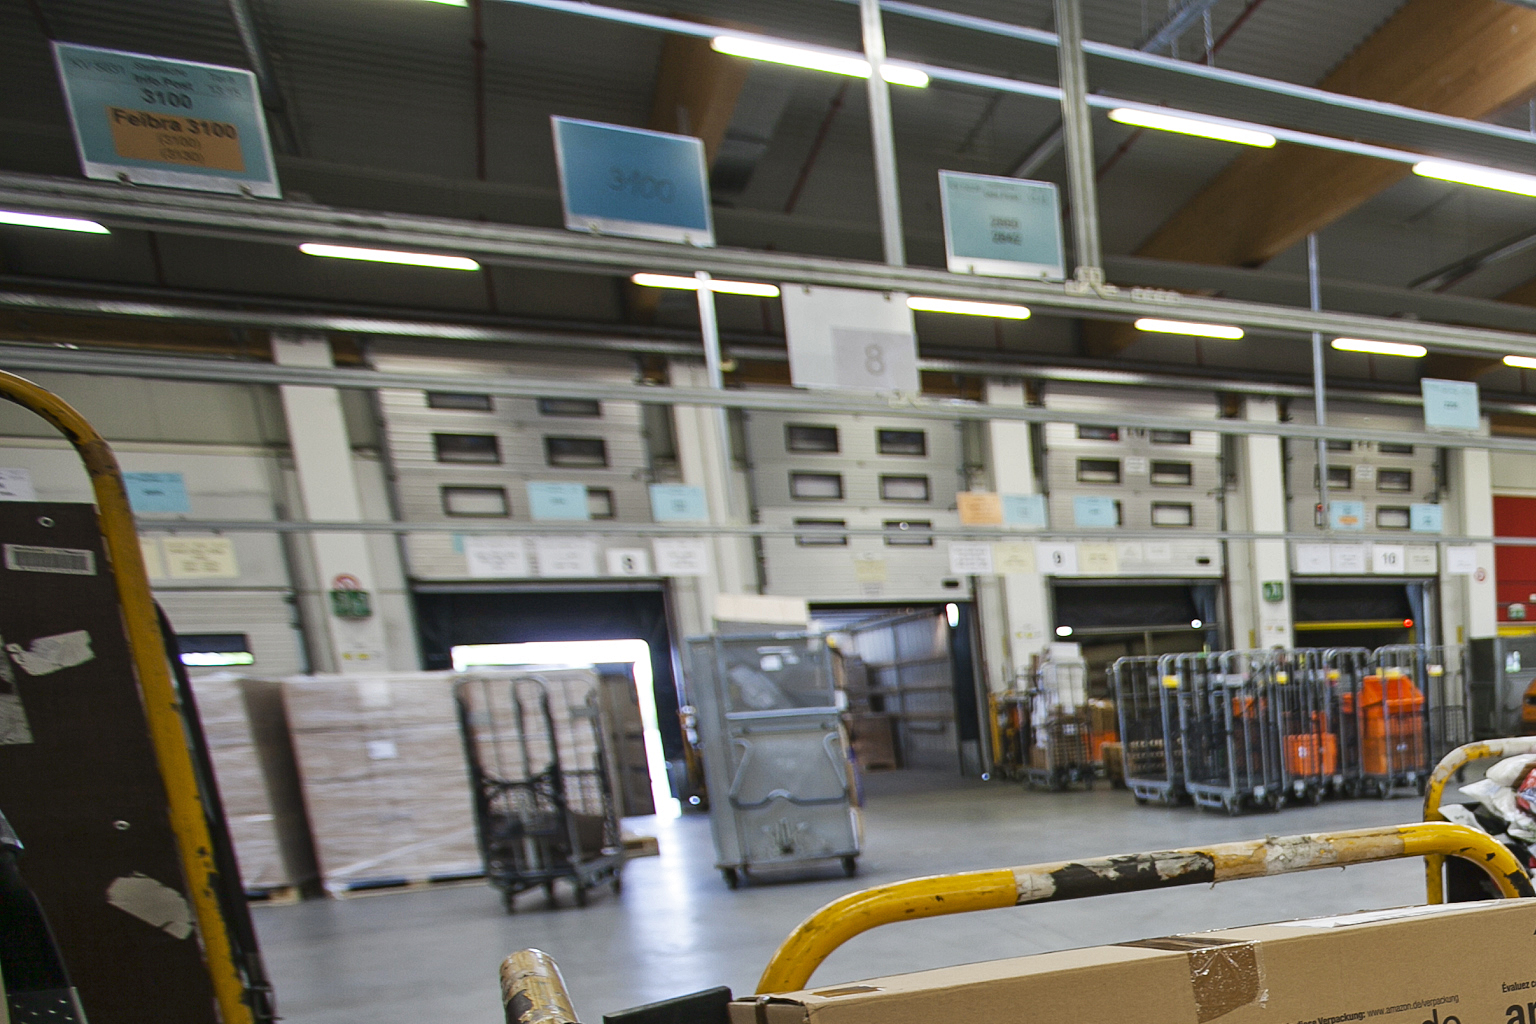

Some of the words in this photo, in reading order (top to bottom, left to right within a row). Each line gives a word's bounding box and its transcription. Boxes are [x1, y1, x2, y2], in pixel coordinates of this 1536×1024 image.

[142, 88, 192, 110] 3100
[187, 118, 237, 139] 3100
[865, 344, 885, 376] 8
[1382, 553, 1396, 565] 10
[1501, 980, 1530, 994] Évaluez
[1366, 992, 1460, 1018] www.amazon.de/verpackung
